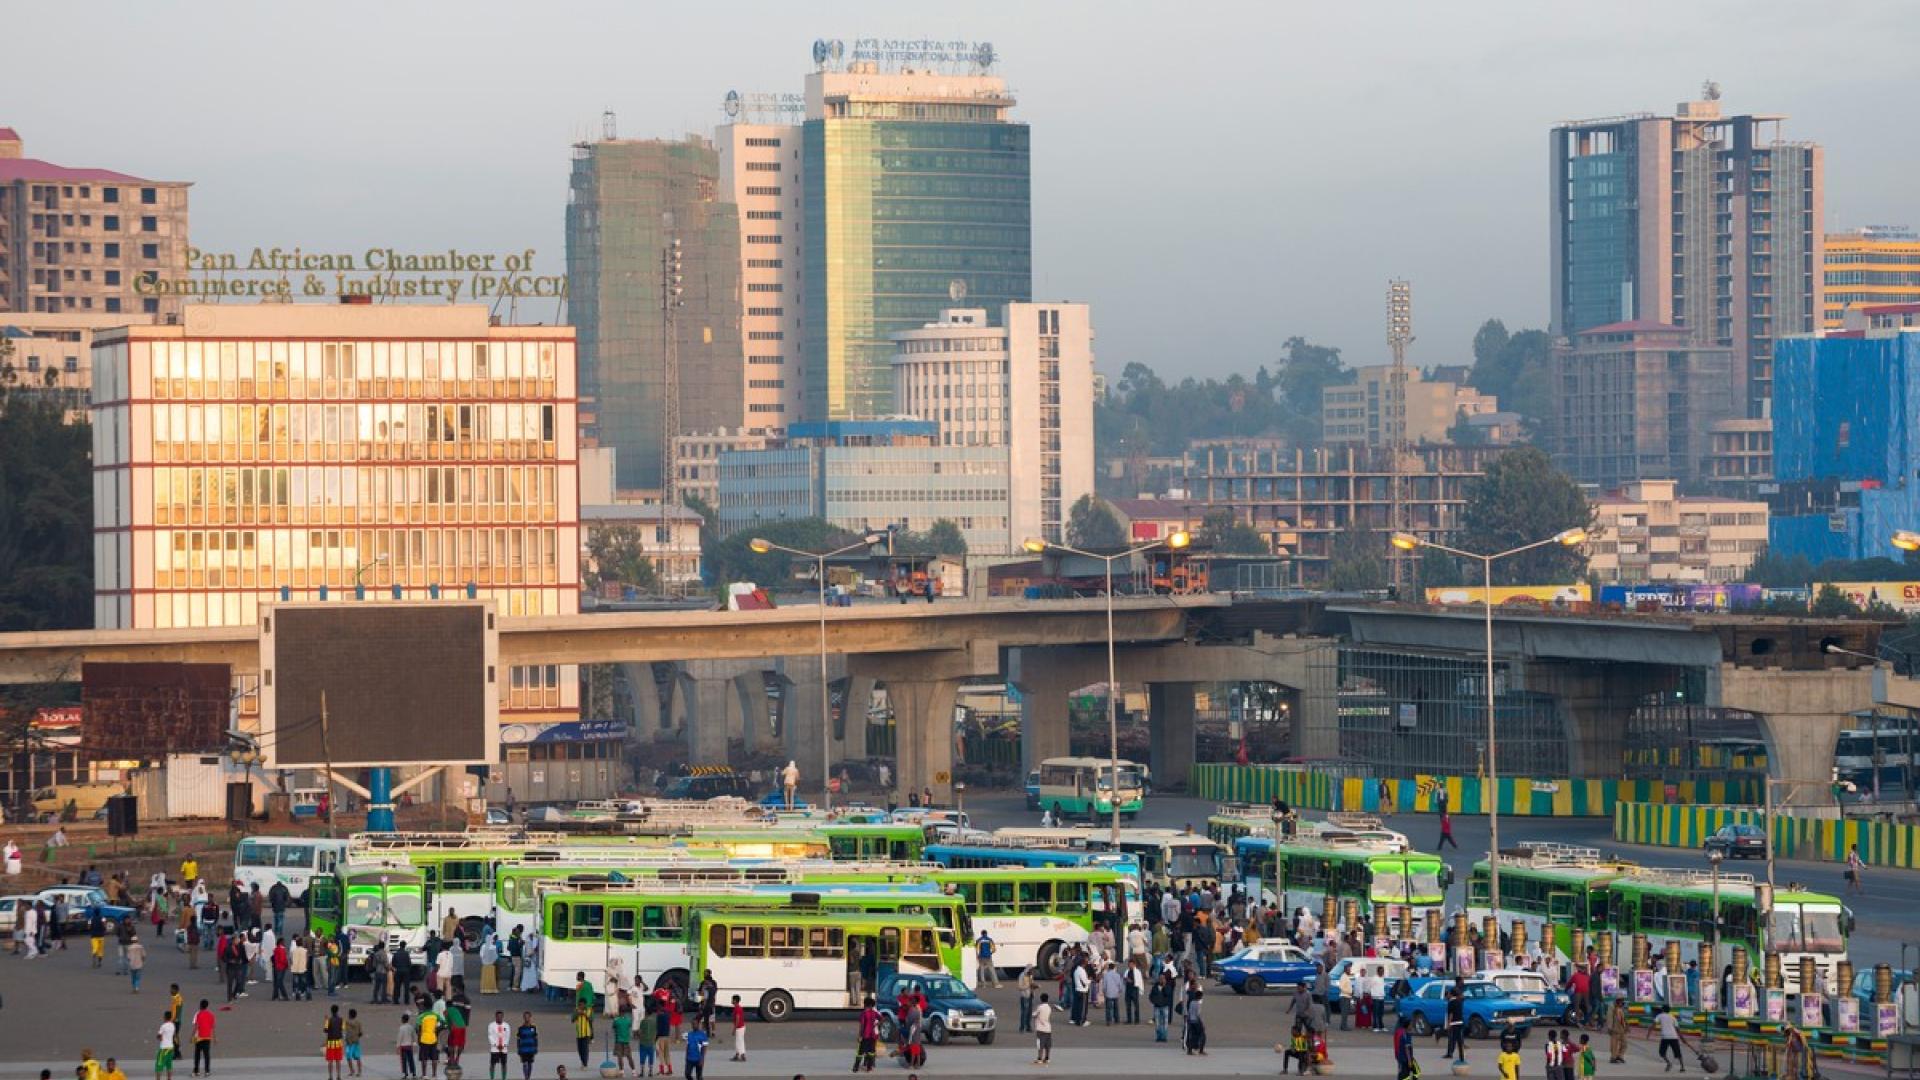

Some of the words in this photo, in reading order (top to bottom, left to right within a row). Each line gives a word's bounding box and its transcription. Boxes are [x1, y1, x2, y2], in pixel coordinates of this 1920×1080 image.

[184, 248, 236, 270] Pan
[248, 247, 355, 270] African
[364, 248, 496, 271] Chamber
[505, 249, 536, 271] of
[133, 273, 291, 296] Commerce
[303, 273, 326, 296] &
[335, 273, 464, 301] Industry
